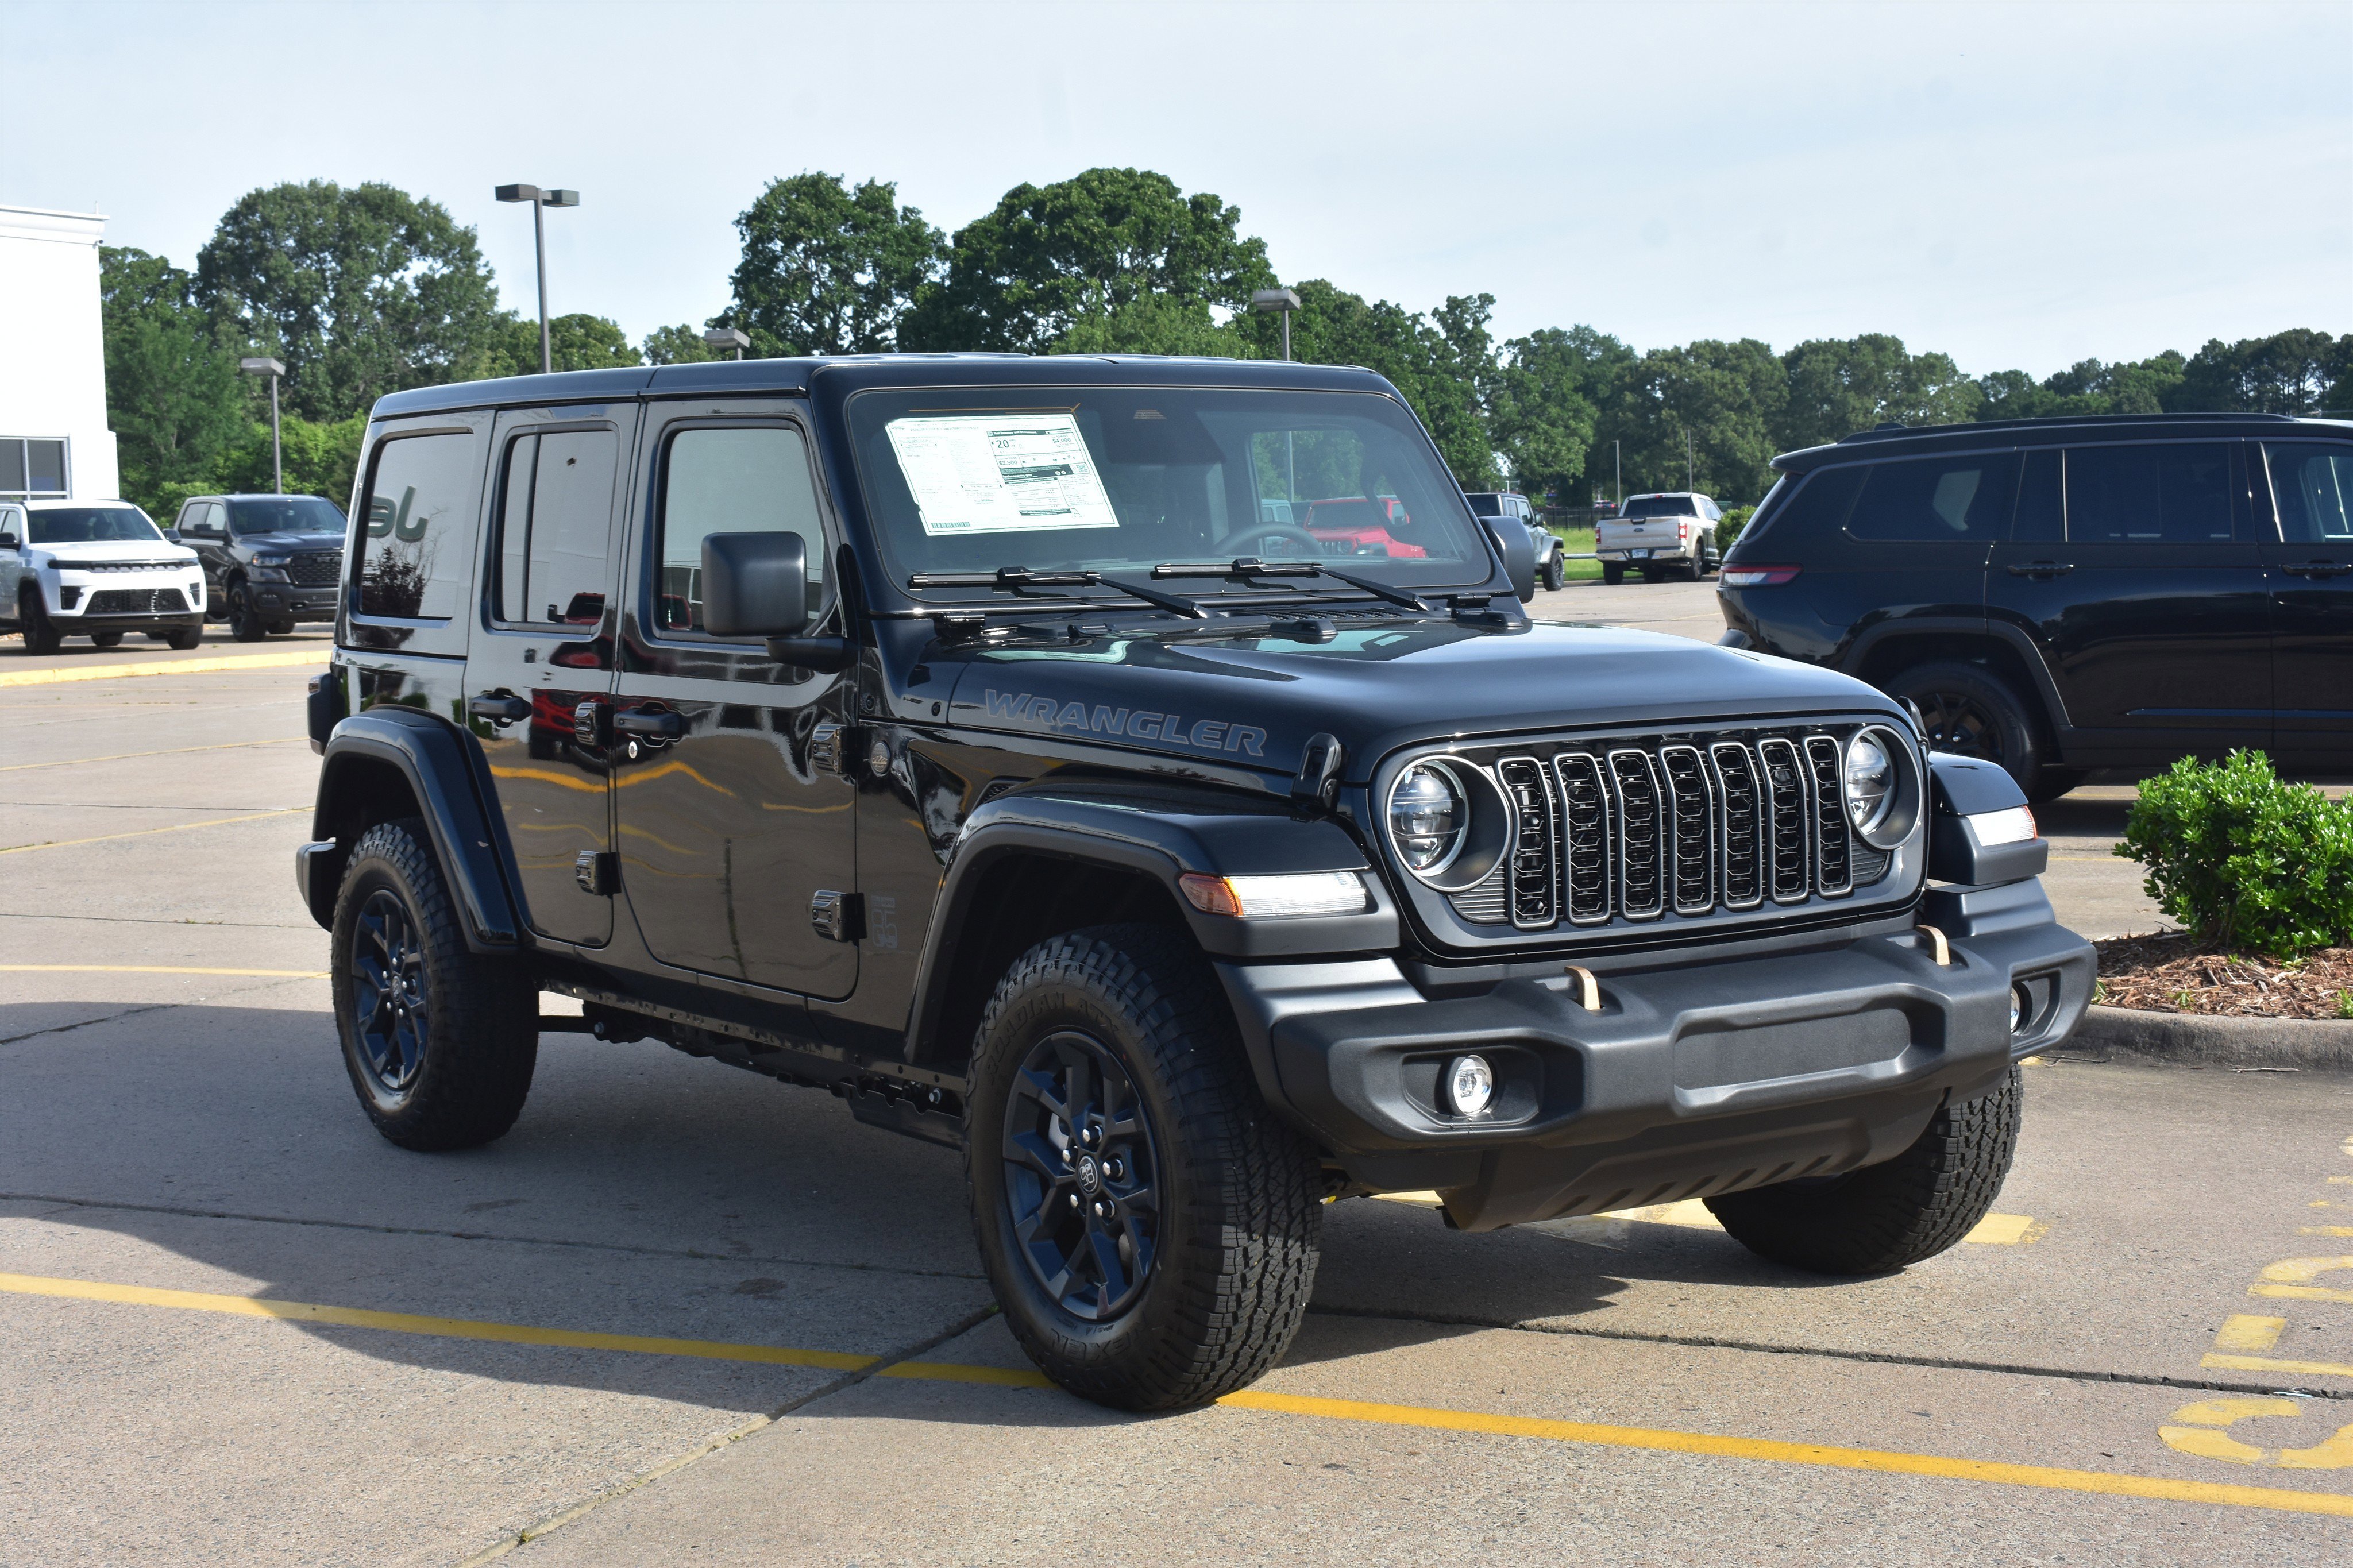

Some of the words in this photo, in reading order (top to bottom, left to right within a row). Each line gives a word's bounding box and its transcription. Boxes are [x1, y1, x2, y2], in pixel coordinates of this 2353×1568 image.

[996, 439, 1009, 448] 20
[985, 689, 1267, 757] WRANGLER
[985, 992, 1065, 1086] ROADIAN
[1074, 997, 1120, 1038] ATX
[1051, 1312, 1148, 1361] NEXEN
